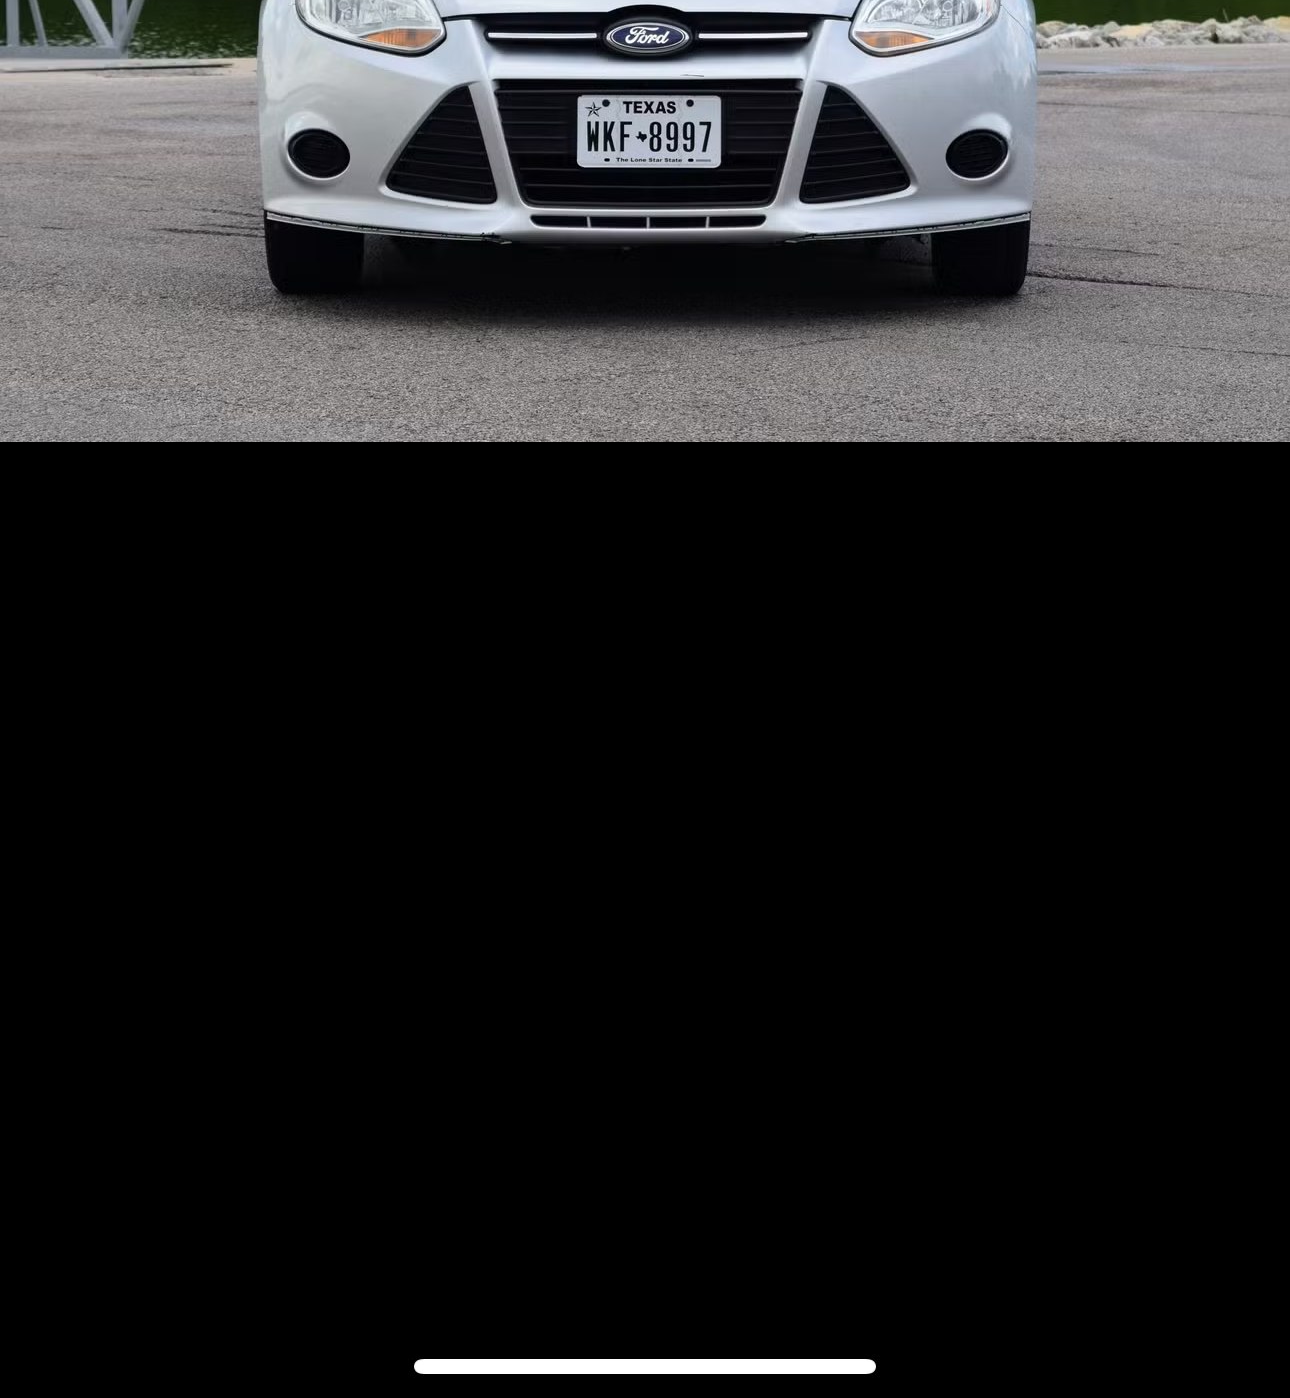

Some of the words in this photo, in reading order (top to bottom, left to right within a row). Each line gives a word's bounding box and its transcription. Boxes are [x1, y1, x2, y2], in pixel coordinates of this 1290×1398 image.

[625, 26, 670, 44] Ford
[623, 101, 676, 114] TEXAS
[587, 121, 633, 152] WKF
[649, 121, 712, 153] 8997
